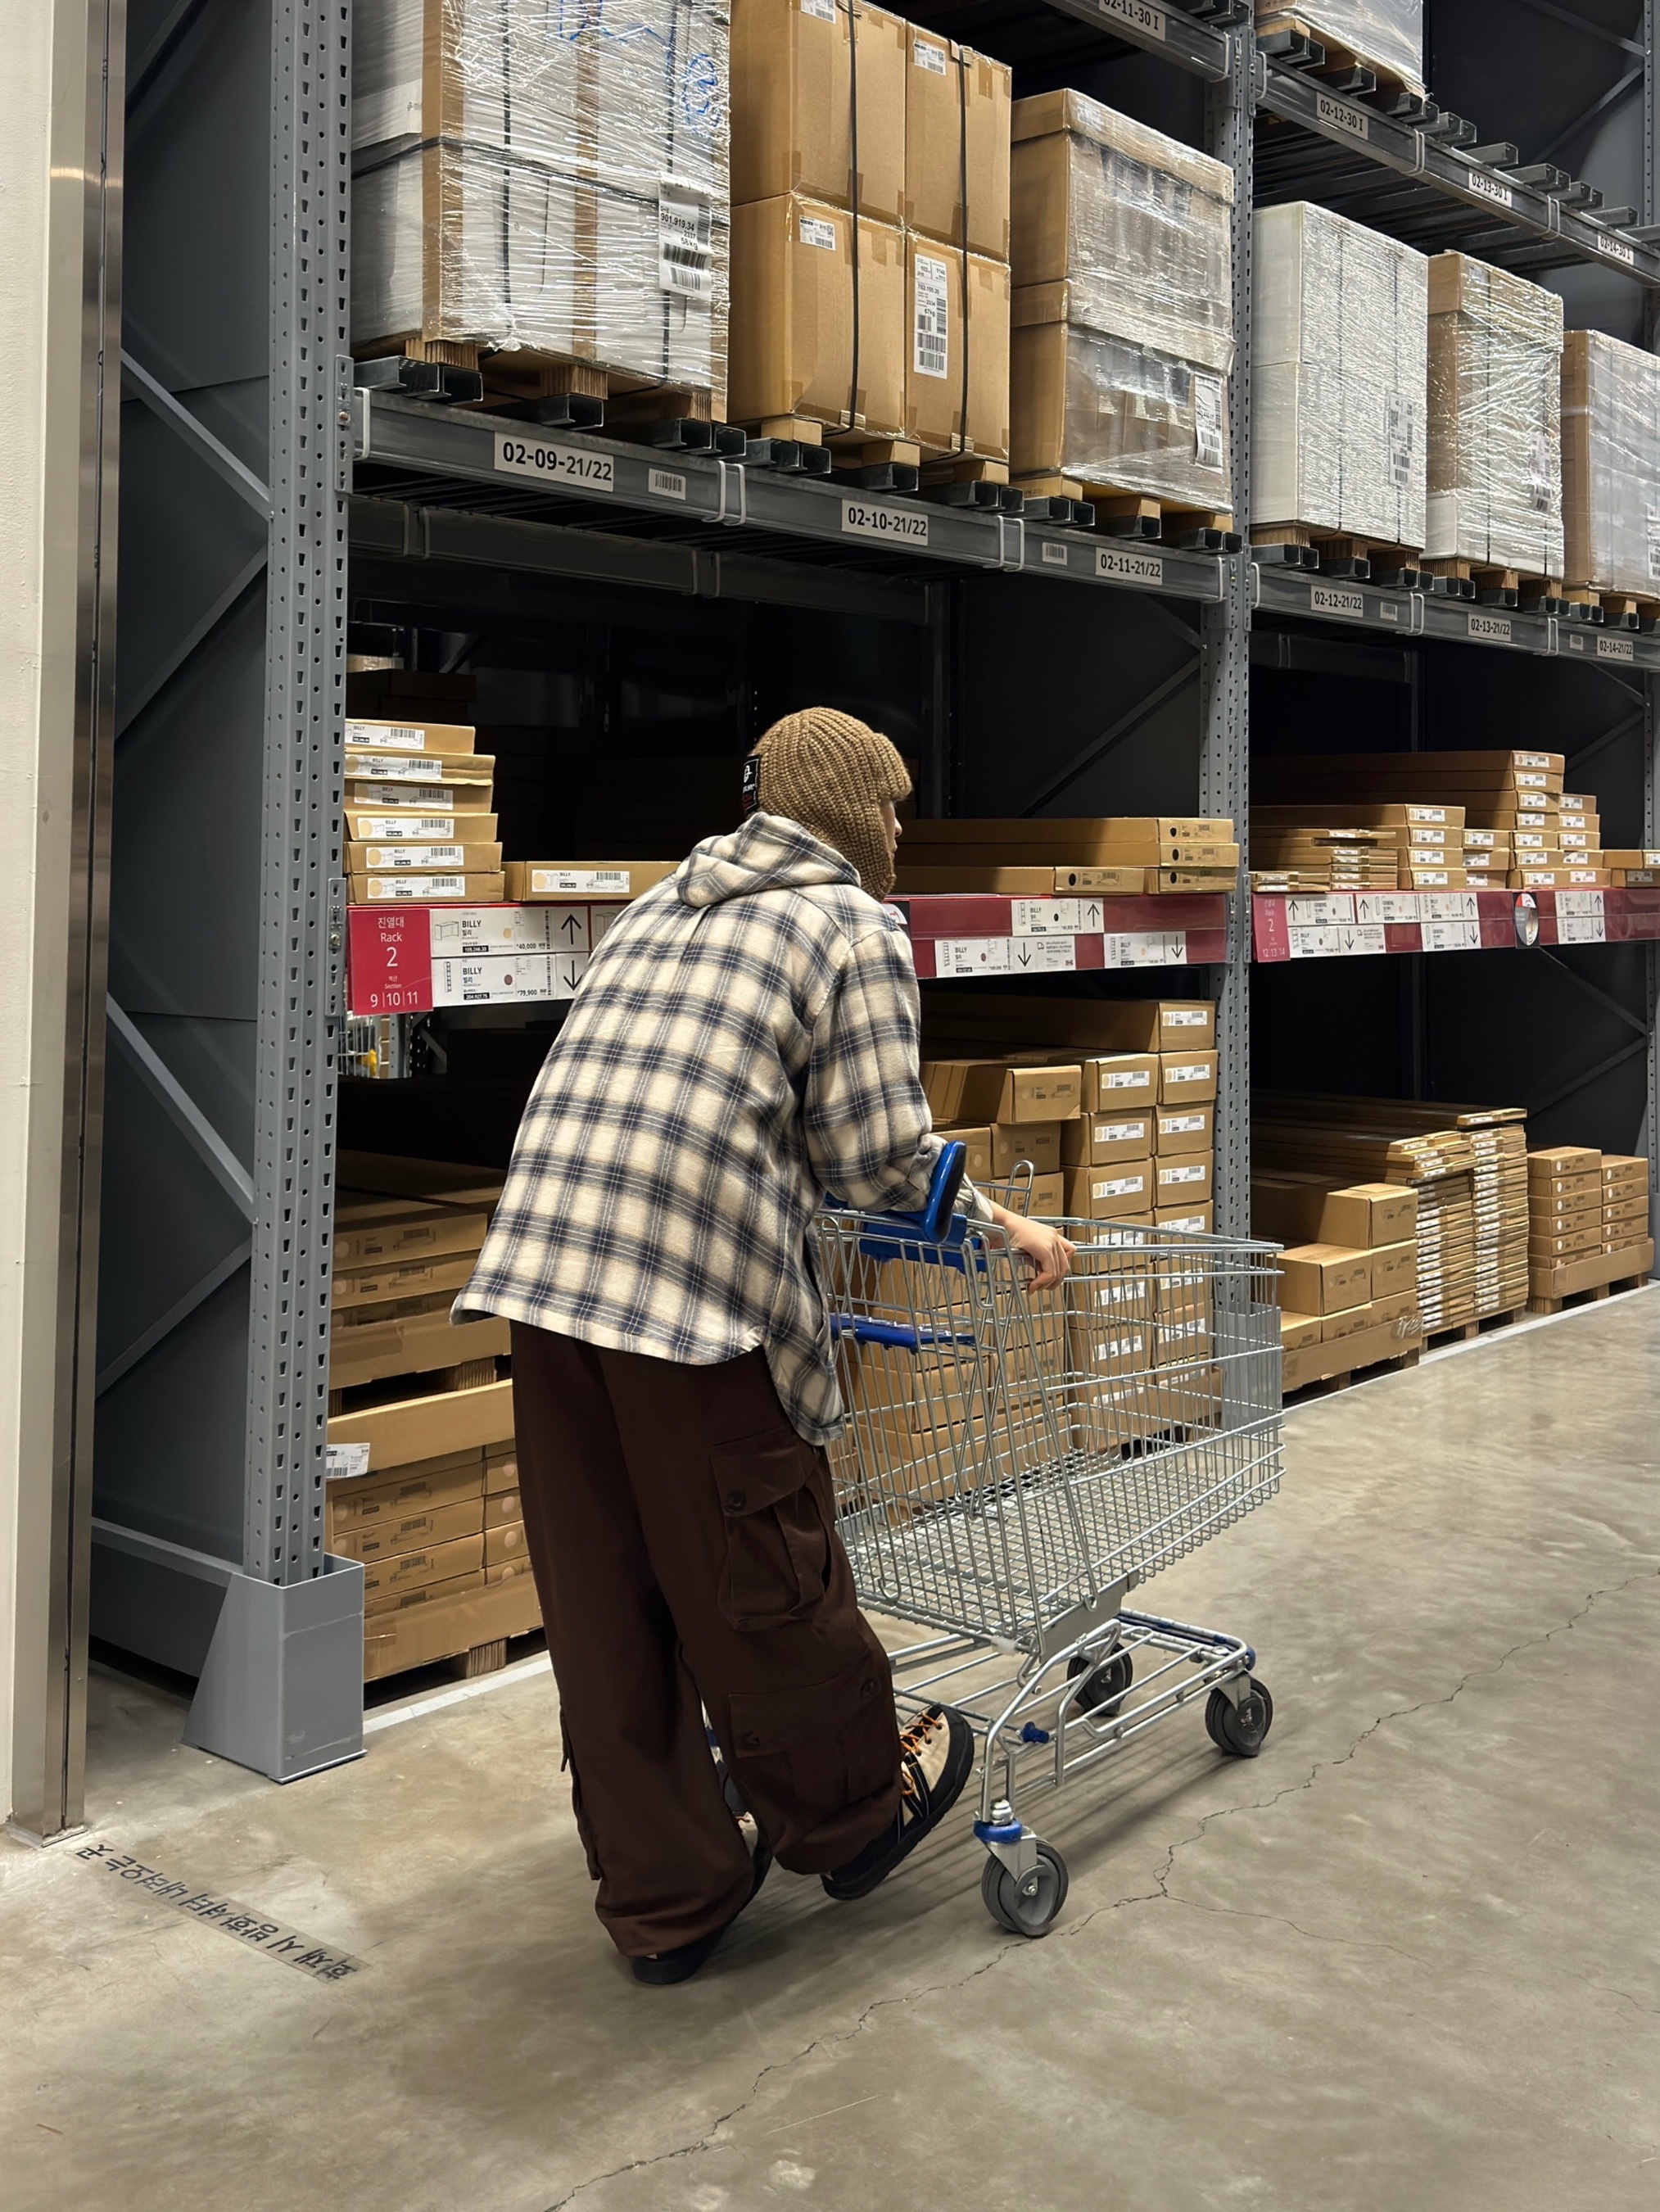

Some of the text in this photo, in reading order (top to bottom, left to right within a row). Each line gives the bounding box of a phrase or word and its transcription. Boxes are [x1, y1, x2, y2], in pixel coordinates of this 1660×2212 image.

[1320, 99, 1357, 129] 02-12-30
[1472, 173, 1503, 198] 02-13-30
[1600, 235, 1626, 258] 02-14-30
[503, 441, 613, 482] 02-09-21/22
[848, 507, 927, 536] 02-10-21/22
[1100, 554, 1161, 578] 02-11-21/22
[1314, 590, 1363, 610] 02-12-21/22
[1471, 618, 1511, 636] 02-13-21/22
[1599, 640, 1634, 655] 02-14-21/22
[378, 916, 405, 929] 진열대
[462, 920, 482, 928] BILLY
[1268, 918, 1275, 932] 2
[380, 932, 403, 943] Rack
[386, 946, 398, 967] 2
[1262, 948, 1269, 957] 12
[1270, 948, 1278, 957] 13
[463, 967, 482, 975] BILLY
[370, 991, 418, 1008] 9 10 11
[75, 1843, 355, 1979] 화재 시 방화셔터 내려오는 곳
